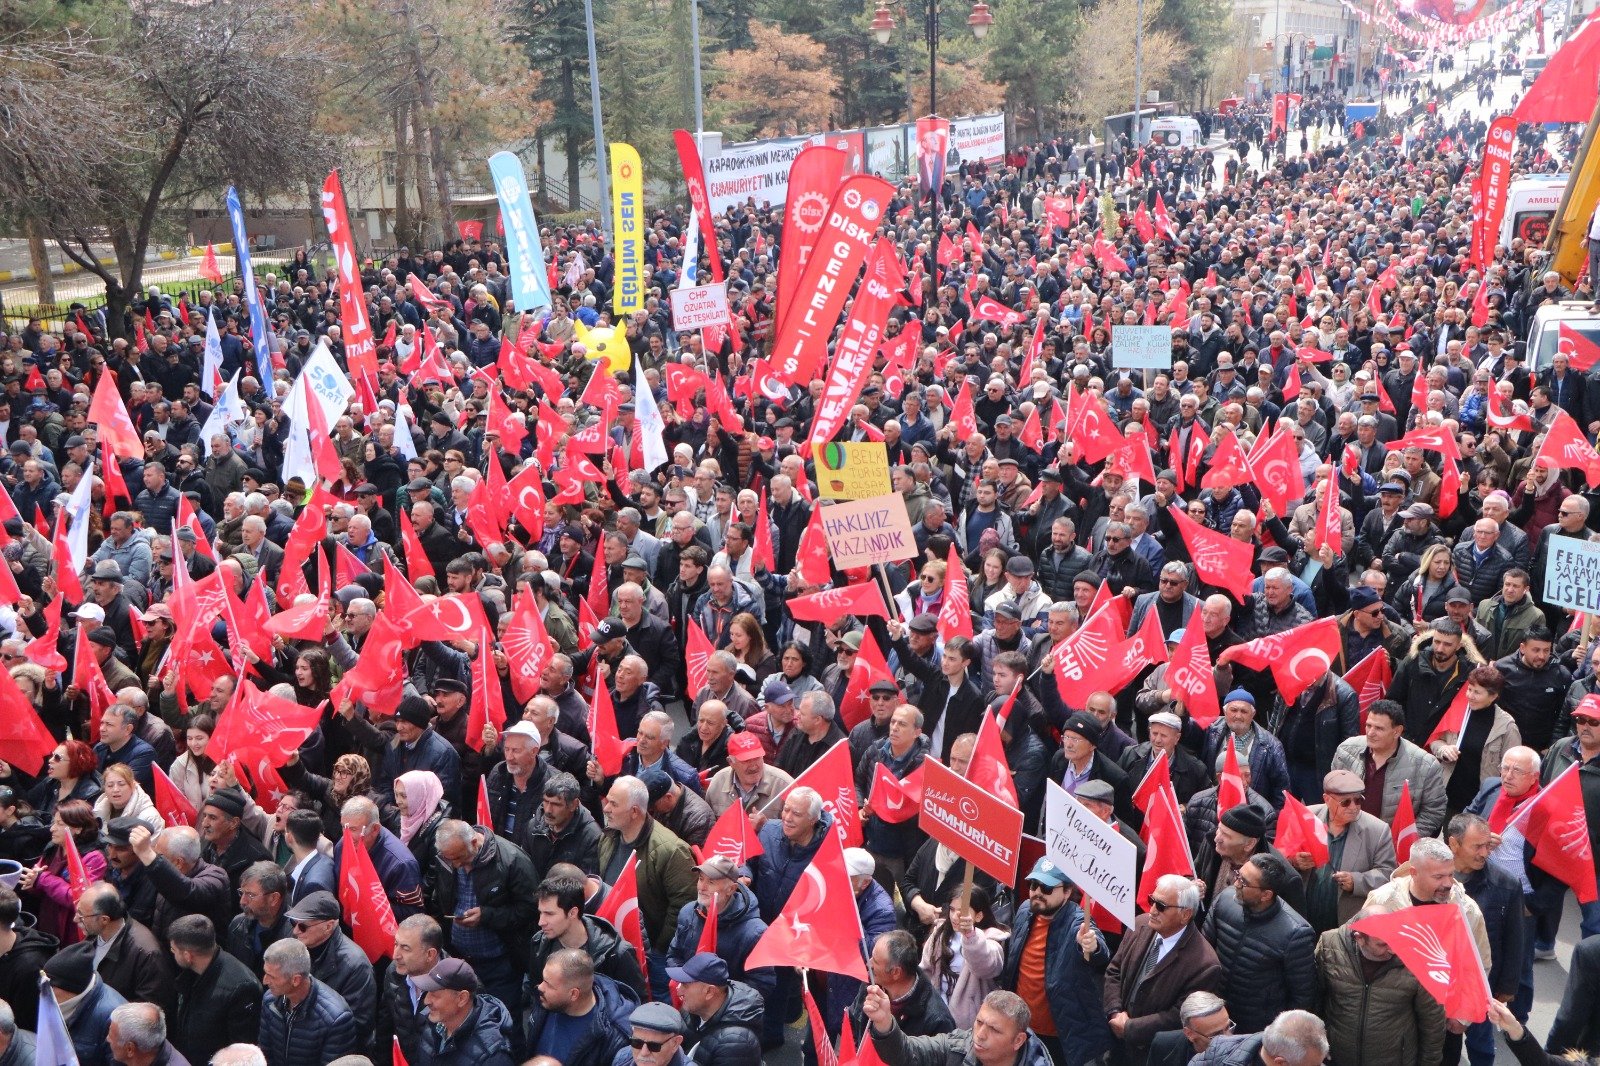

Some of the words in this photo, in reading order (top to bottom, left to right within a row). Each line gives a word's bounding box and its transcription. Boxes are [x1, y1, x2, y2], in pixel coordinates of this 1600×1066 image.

[1487, 144, 1510, 161] DİSK
[830, 212, 871, 245] DİSK
[689, 290, 708, 301] CHP
[314, 384, 343, 405] PARTİ
[825, 509, 894, 537] HAKLIYIZ
[832, 530, 905, 558] KAZANDIK
[942, 600, 960, 630] HP
[1059, 645, 1083, 681] CHP
[1174, 667, 1207, 696] CHP
[924, 798, 1013, 861] CUMHURİYET
[1064, 803, 1112, 856] Yaşasın
[1050, 828, 1079, 867] Türk
